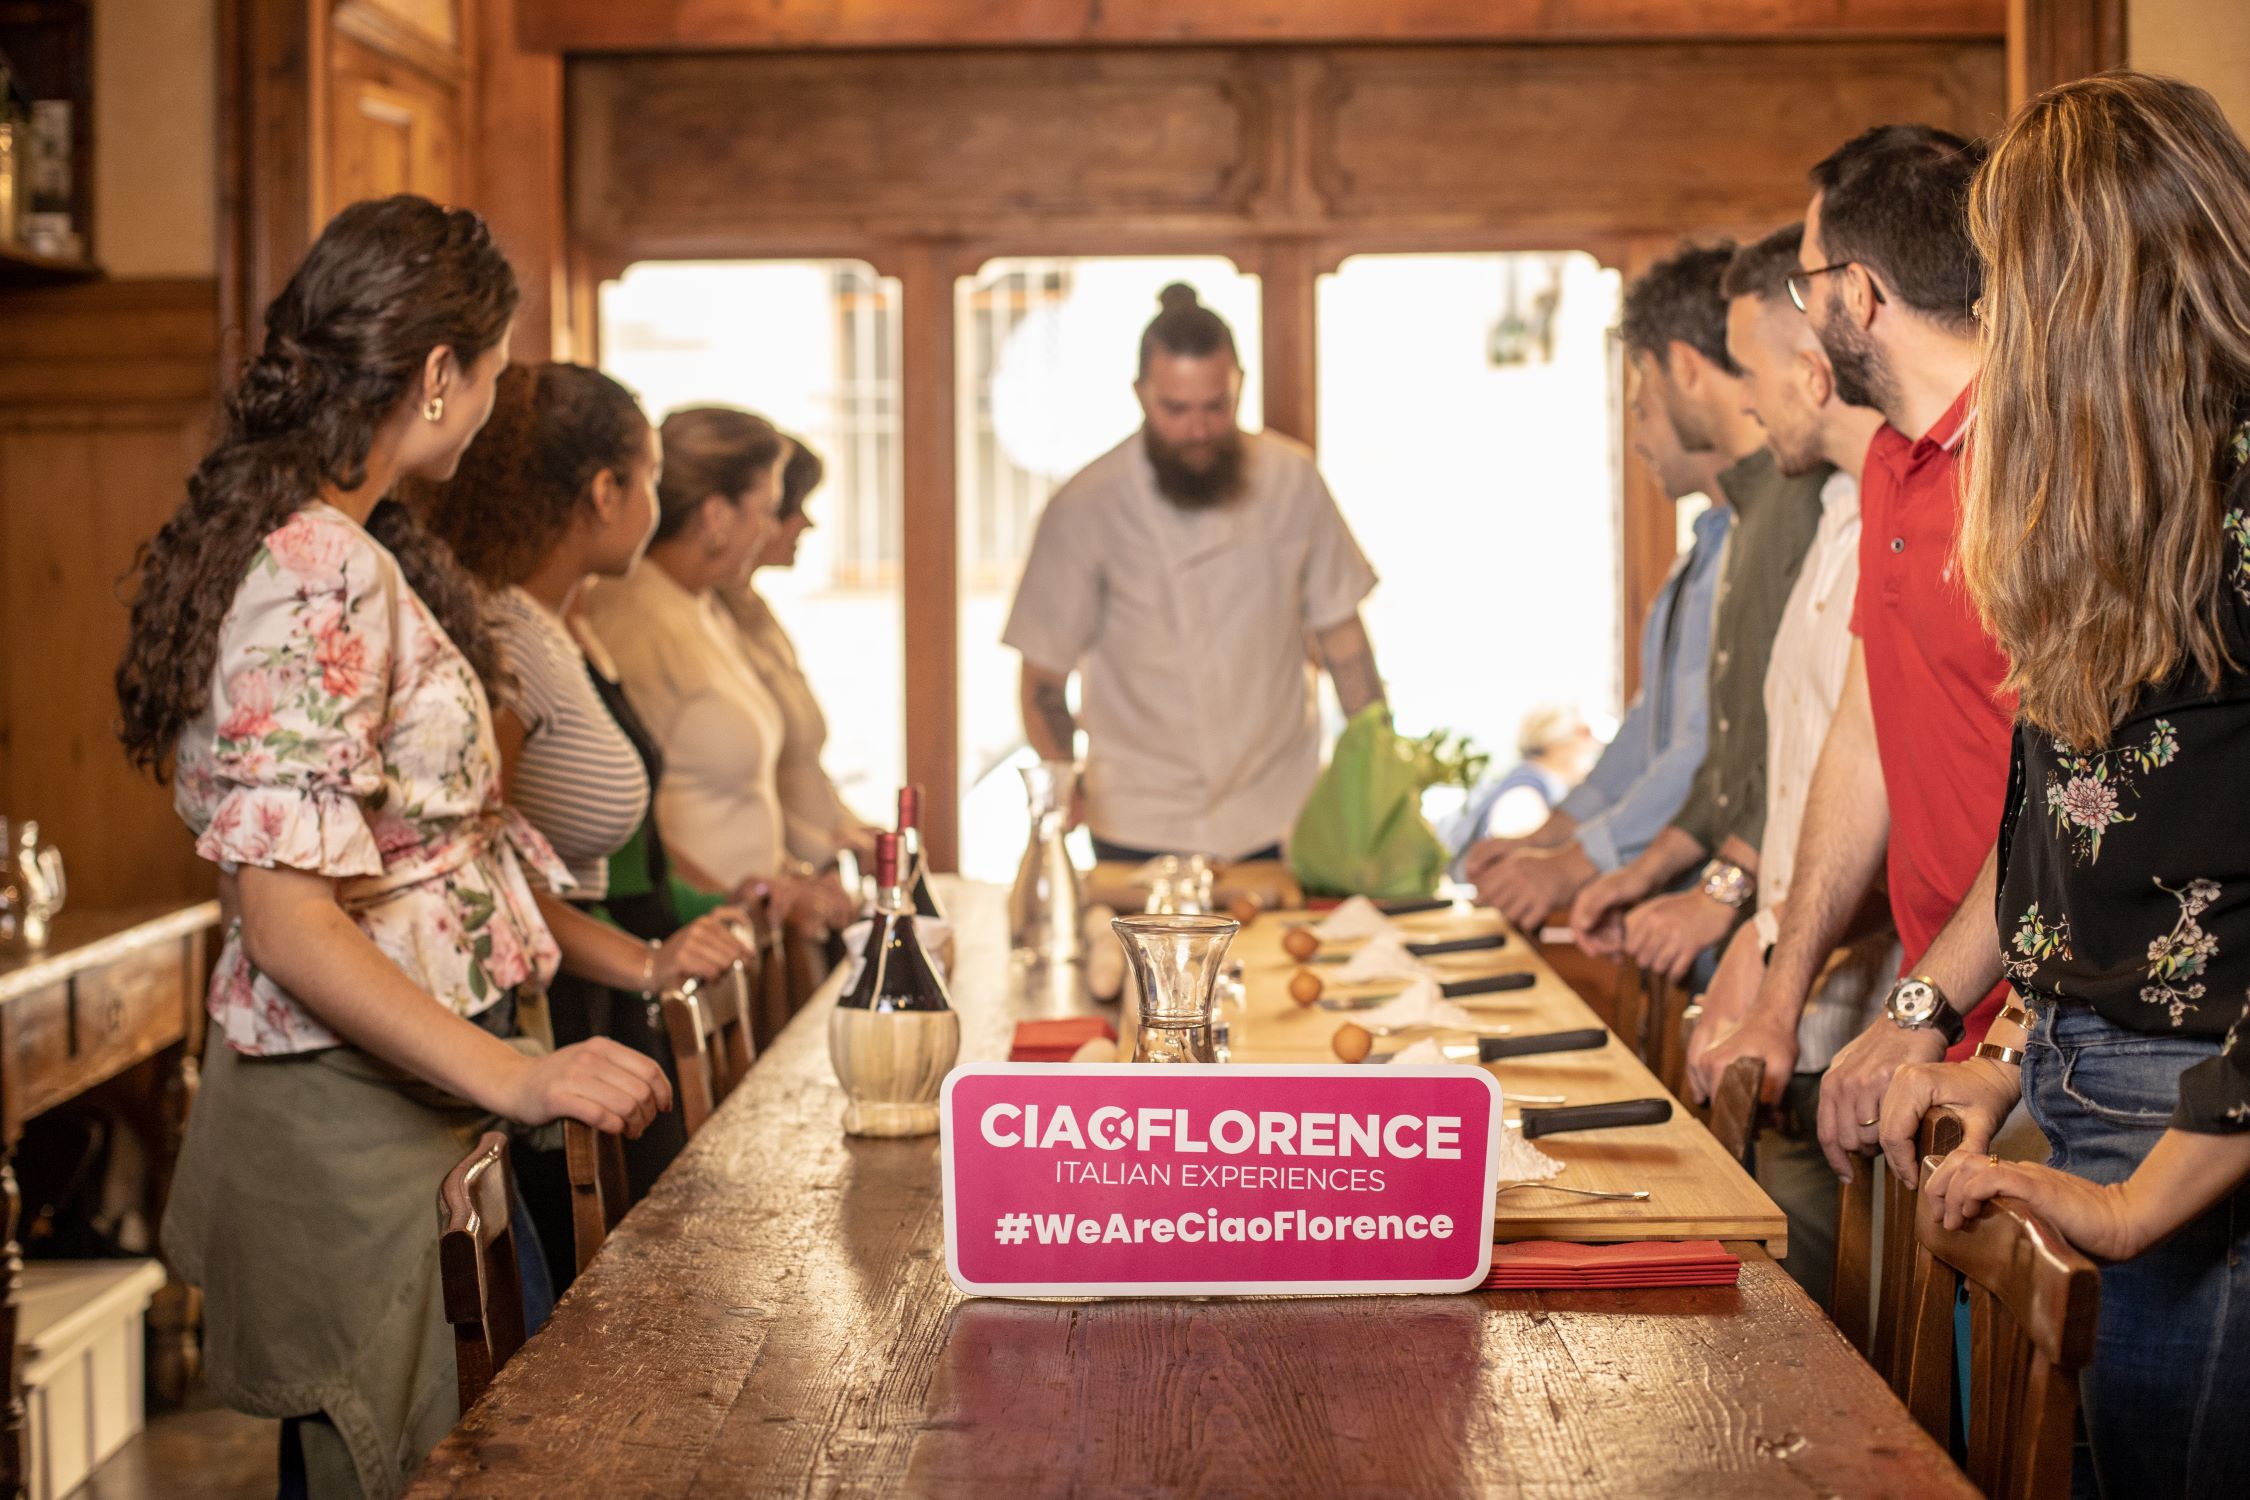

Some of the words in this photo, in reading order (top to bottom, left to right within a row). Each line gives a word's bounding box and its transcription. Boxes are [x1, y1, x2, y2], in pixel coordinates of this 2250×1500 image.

[1056, 1160, 1171, 1186] ITALIAN
[1181, 1164, 1386, 1192] EXPERIENCES
[994, 1207, 1454, 1245] #WeAreCiaoFlorence
